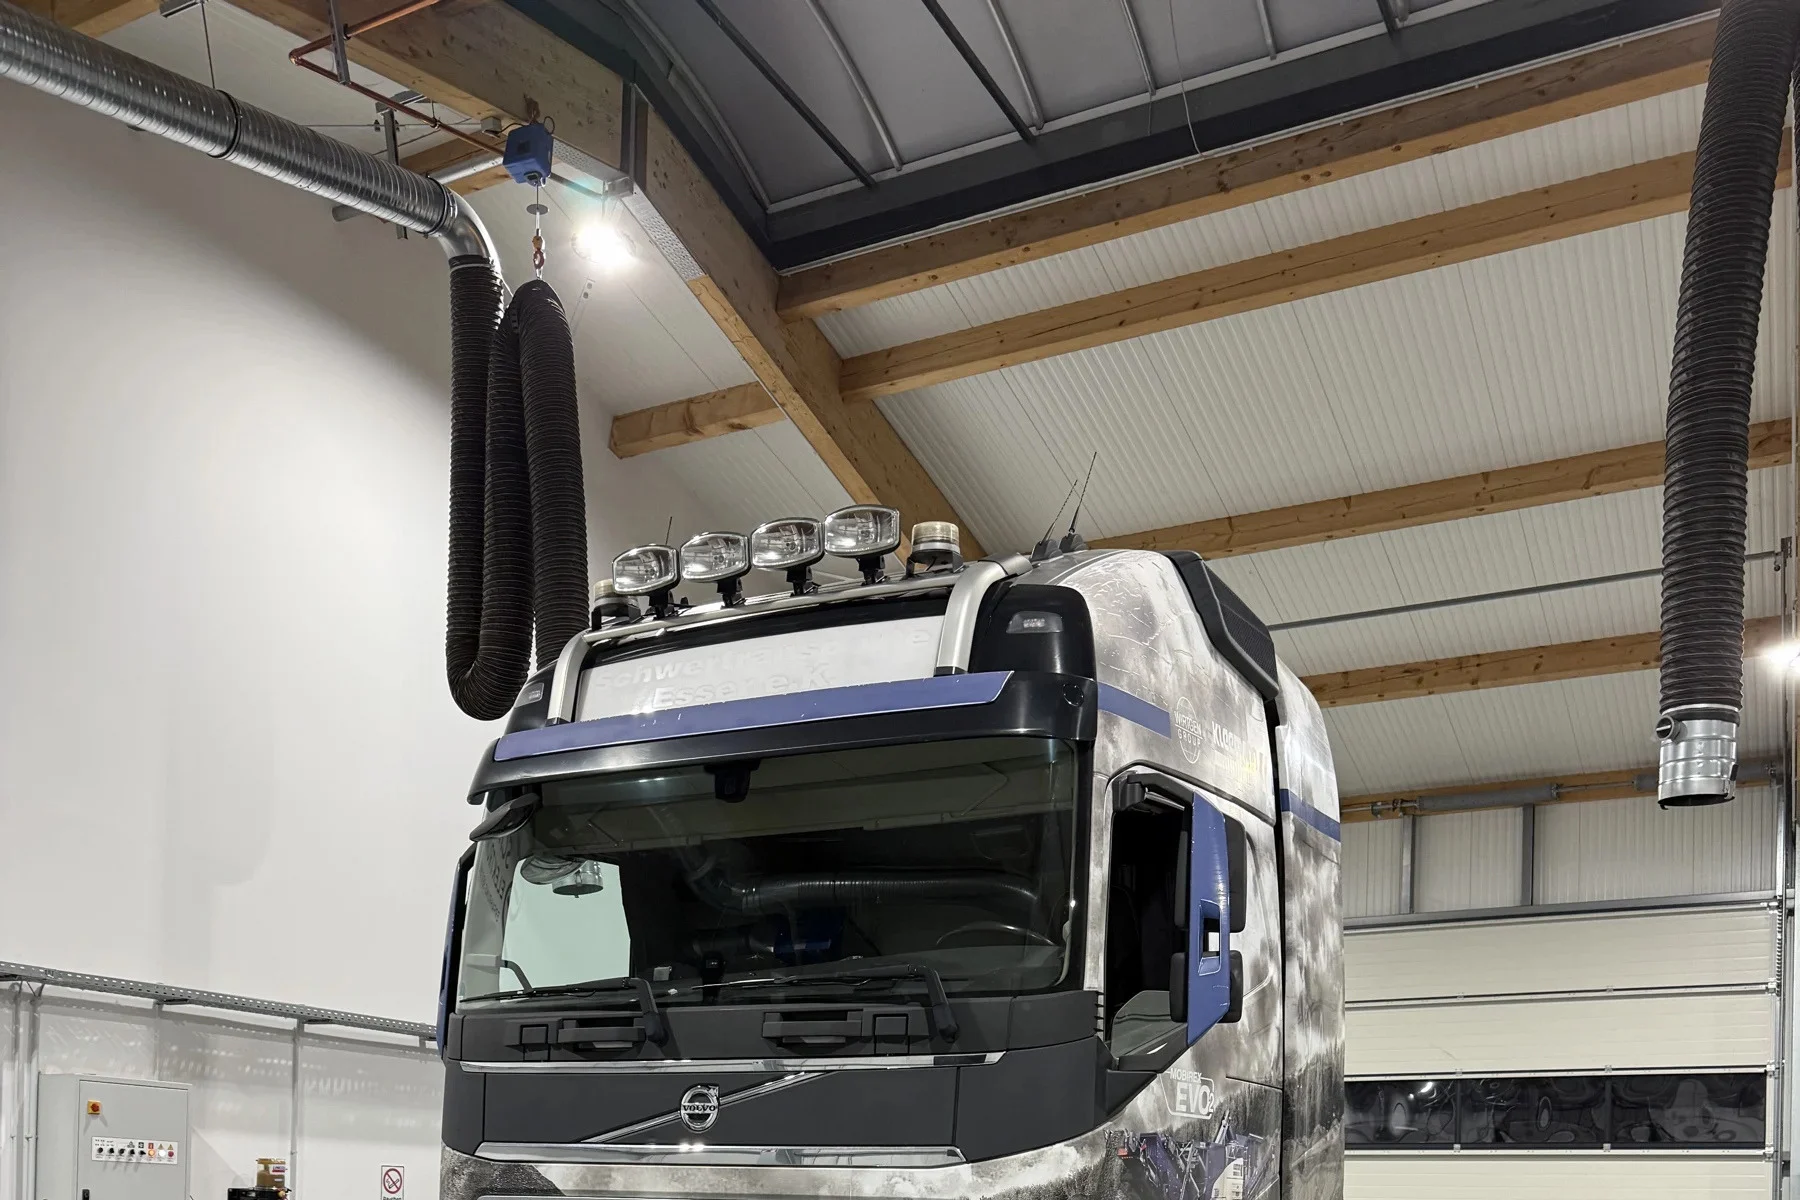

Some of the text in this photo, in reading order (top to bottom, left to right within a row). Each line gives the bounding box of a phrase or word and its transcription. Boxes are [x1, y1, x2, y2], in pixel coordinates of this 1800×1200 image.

[1174, 711, 1202, 736] WIRTGEN
[1177, 728, 1201, 747] GROUP
[1170, 1068, 1202, 1083] MOBIREX
[683, 1104, 716, 1112] VOLVO
